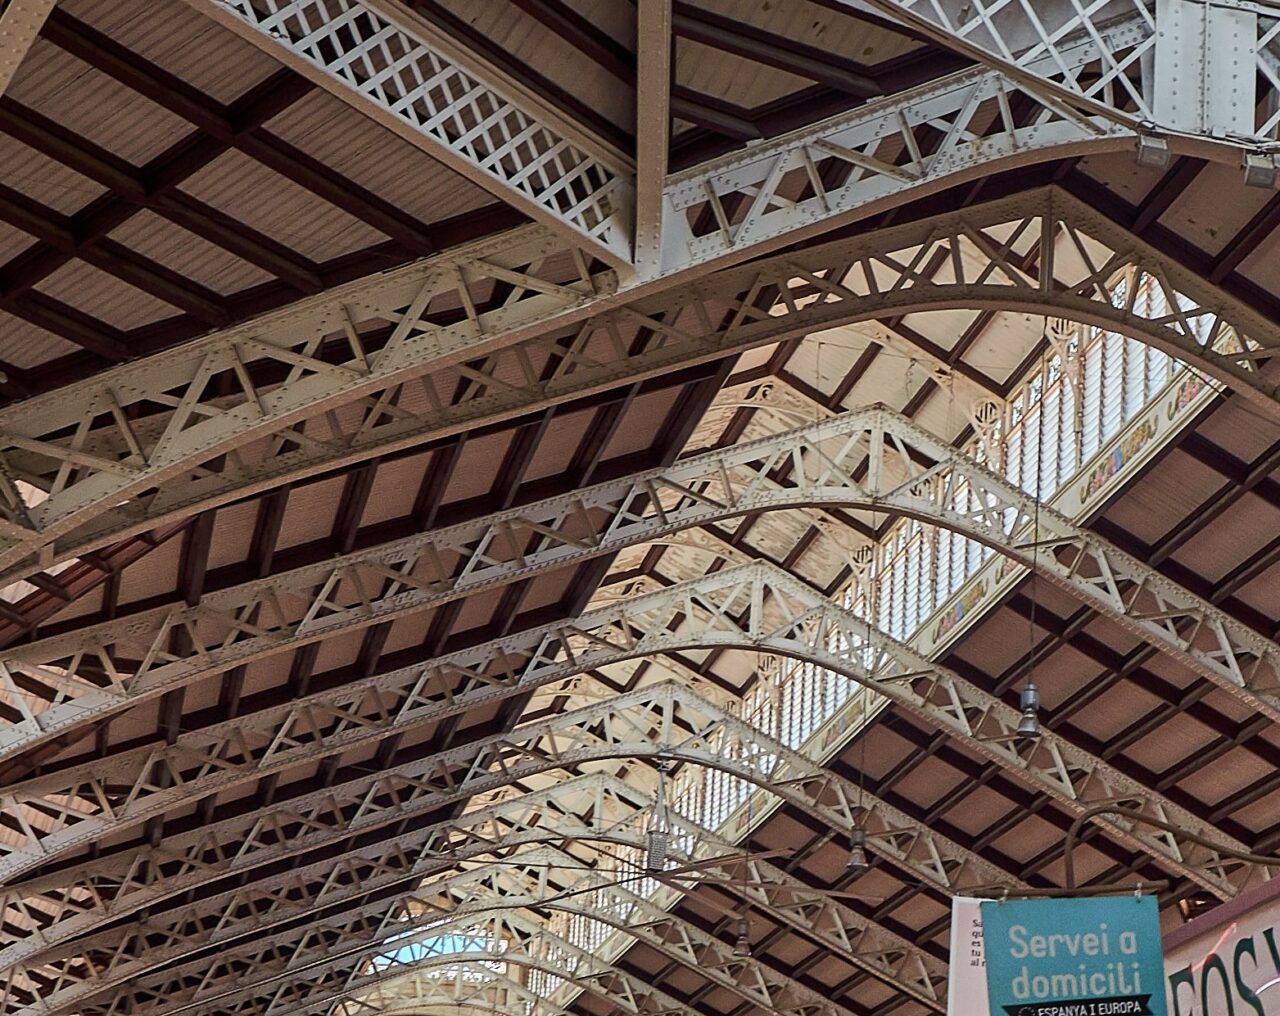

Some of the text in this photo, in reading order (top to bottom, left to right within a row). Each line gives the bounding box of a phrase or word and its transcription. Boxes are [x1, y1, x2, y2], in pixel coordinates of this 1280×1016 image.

[1009, 923, 1137, 959] Servei a
[1012, 962, 1141, 1000] domicili
[1089, 1004, 1096, 1016] I
[1098, 1000, 1142, 1016] EUROPA
